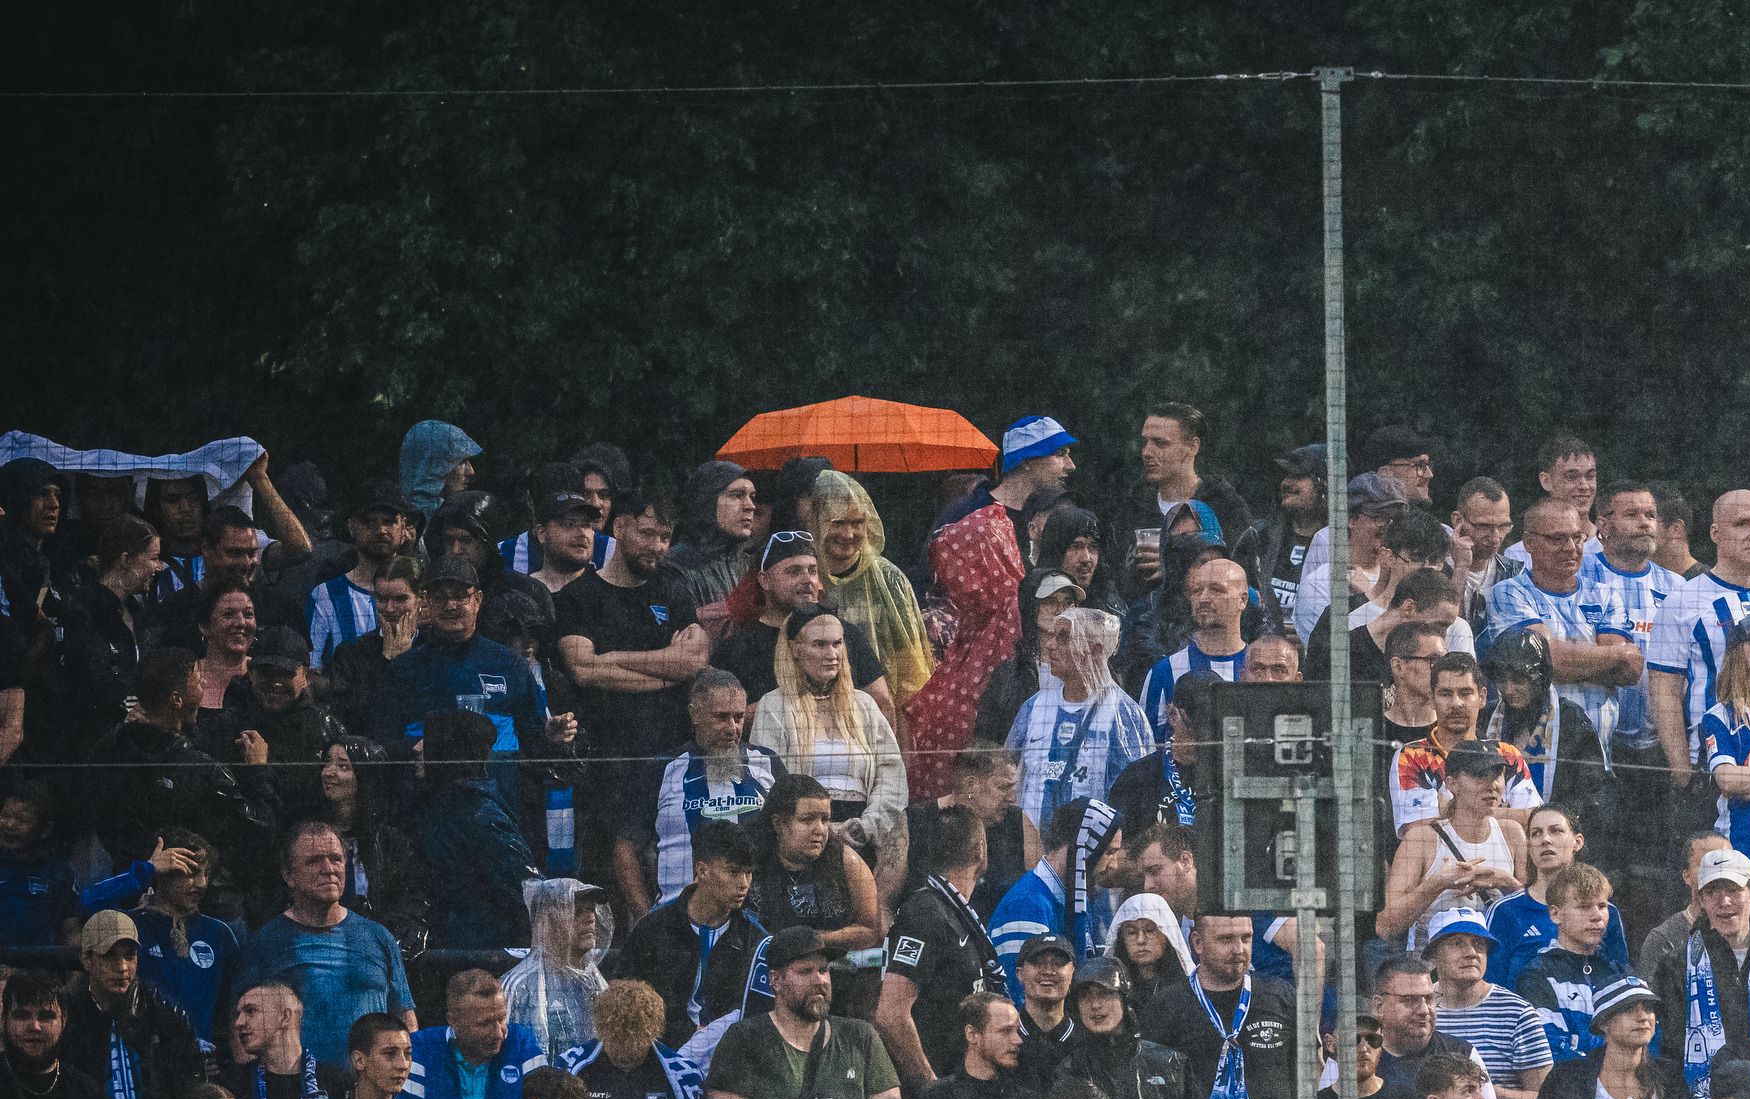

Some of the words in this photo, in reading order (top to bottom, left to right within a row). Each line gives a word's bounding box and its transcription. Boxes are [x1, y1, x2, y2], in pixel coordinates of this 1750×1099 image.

[682, 794, 764, 811] bet-at-home
[1074, 798, 1118, 914] HERTHA
[1711, 1010, 1723, 1036] WIR
